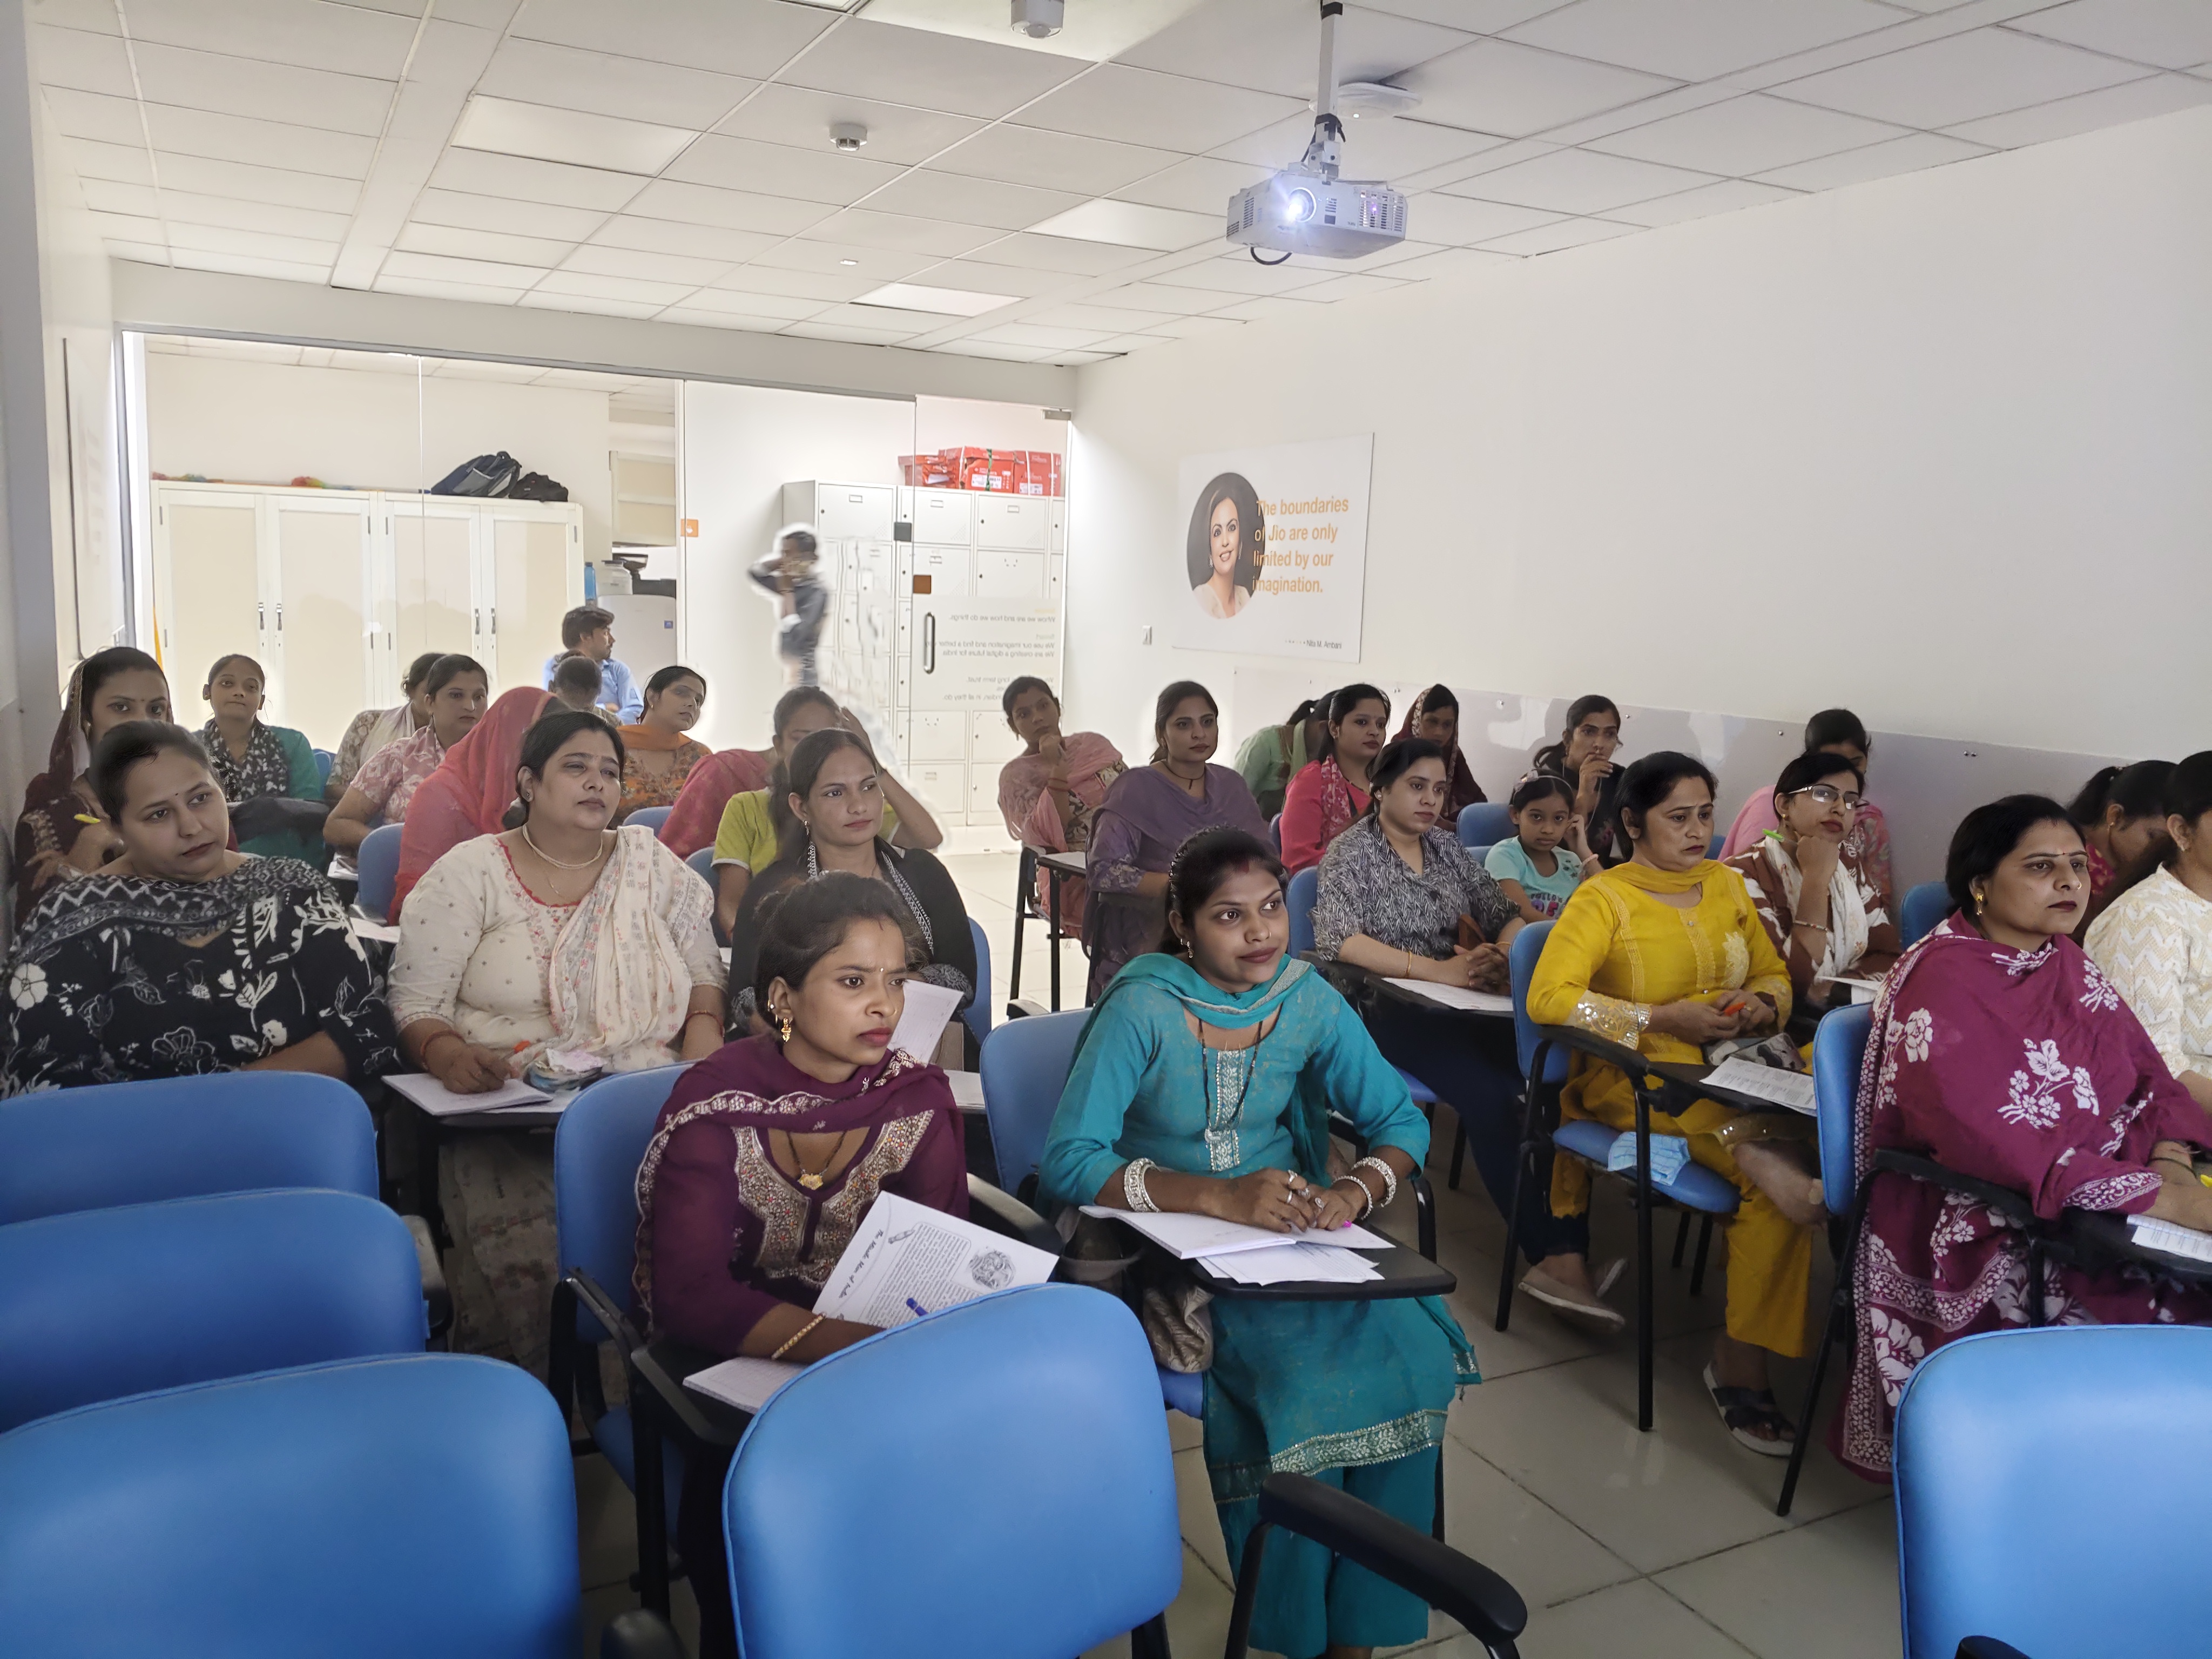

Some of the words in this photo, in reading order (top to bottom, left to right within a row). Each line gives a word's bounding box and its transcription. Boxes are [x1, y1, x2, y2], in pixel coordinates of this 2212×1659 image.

[1256, 500, 1277, 517] The
[1280, 496, 1349, 515] boundaries
[1269, 524, 1286, 541] Jio
[1290, 528, 1308, 541] are
[1312, 523, 1338, 543] only
[1253, 549, 1292, 567] limited
[1295, 550, 1310, 570] by
[1313, 554, 1334, 567] our
[1252, 575, 1323, 595] imagination.
